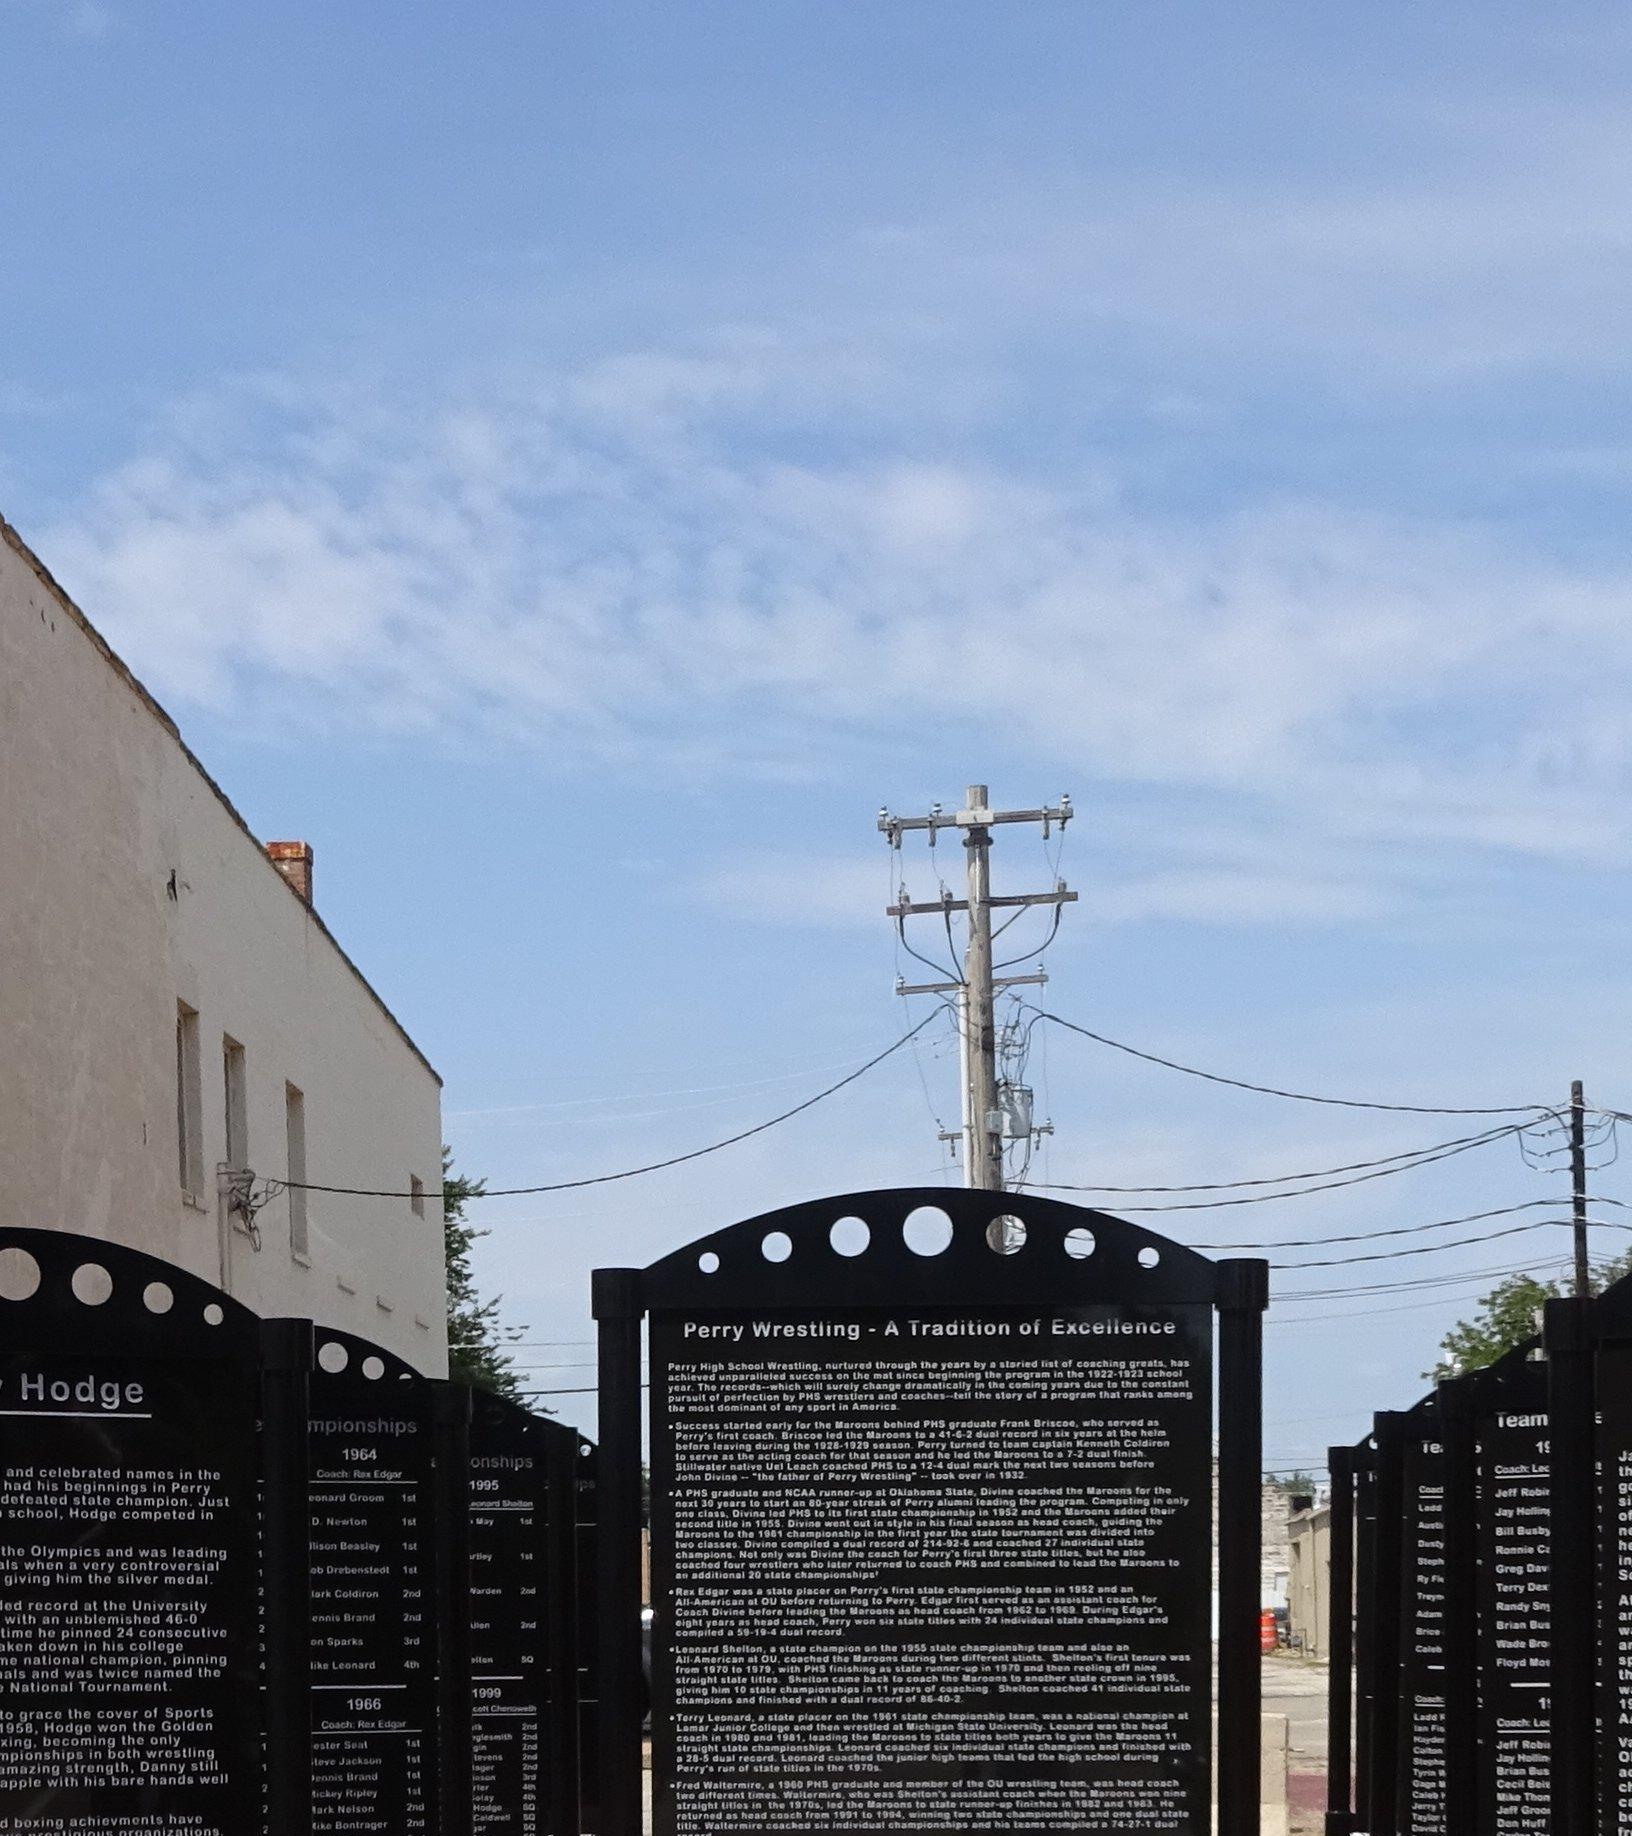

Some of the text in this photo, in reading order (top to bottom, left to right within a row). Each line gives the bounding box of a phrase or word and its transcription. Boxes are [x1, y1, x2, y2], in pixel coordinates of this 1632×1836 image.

[684, 1322, 744, 1342] Perry
[752, 1321, 860, 1341] Wrestling
[884, 1320, 899, 1336] A
[908, 1320, 1010, 1336] Tradition
[1019, 1319, 1040, 1336] of
[1051, 1319, 1176, 1335] Excellence
[21, 1373, 144, 1410] Hodge
[342, 1448, 378, 1461] 1964
[6, 1466, 34, 1478] and
[39, 1466, 121, 1479] celebrated
[126, 1470, 174, 1480] names
[179, 1468, 193, 1480] in
[198, 1469, 221, 1481] the
[469, 1479, 500, 1491] 1995
[308, 1493, 346, 1503] eonard
[346, 1697, 382, 1711] 1966
